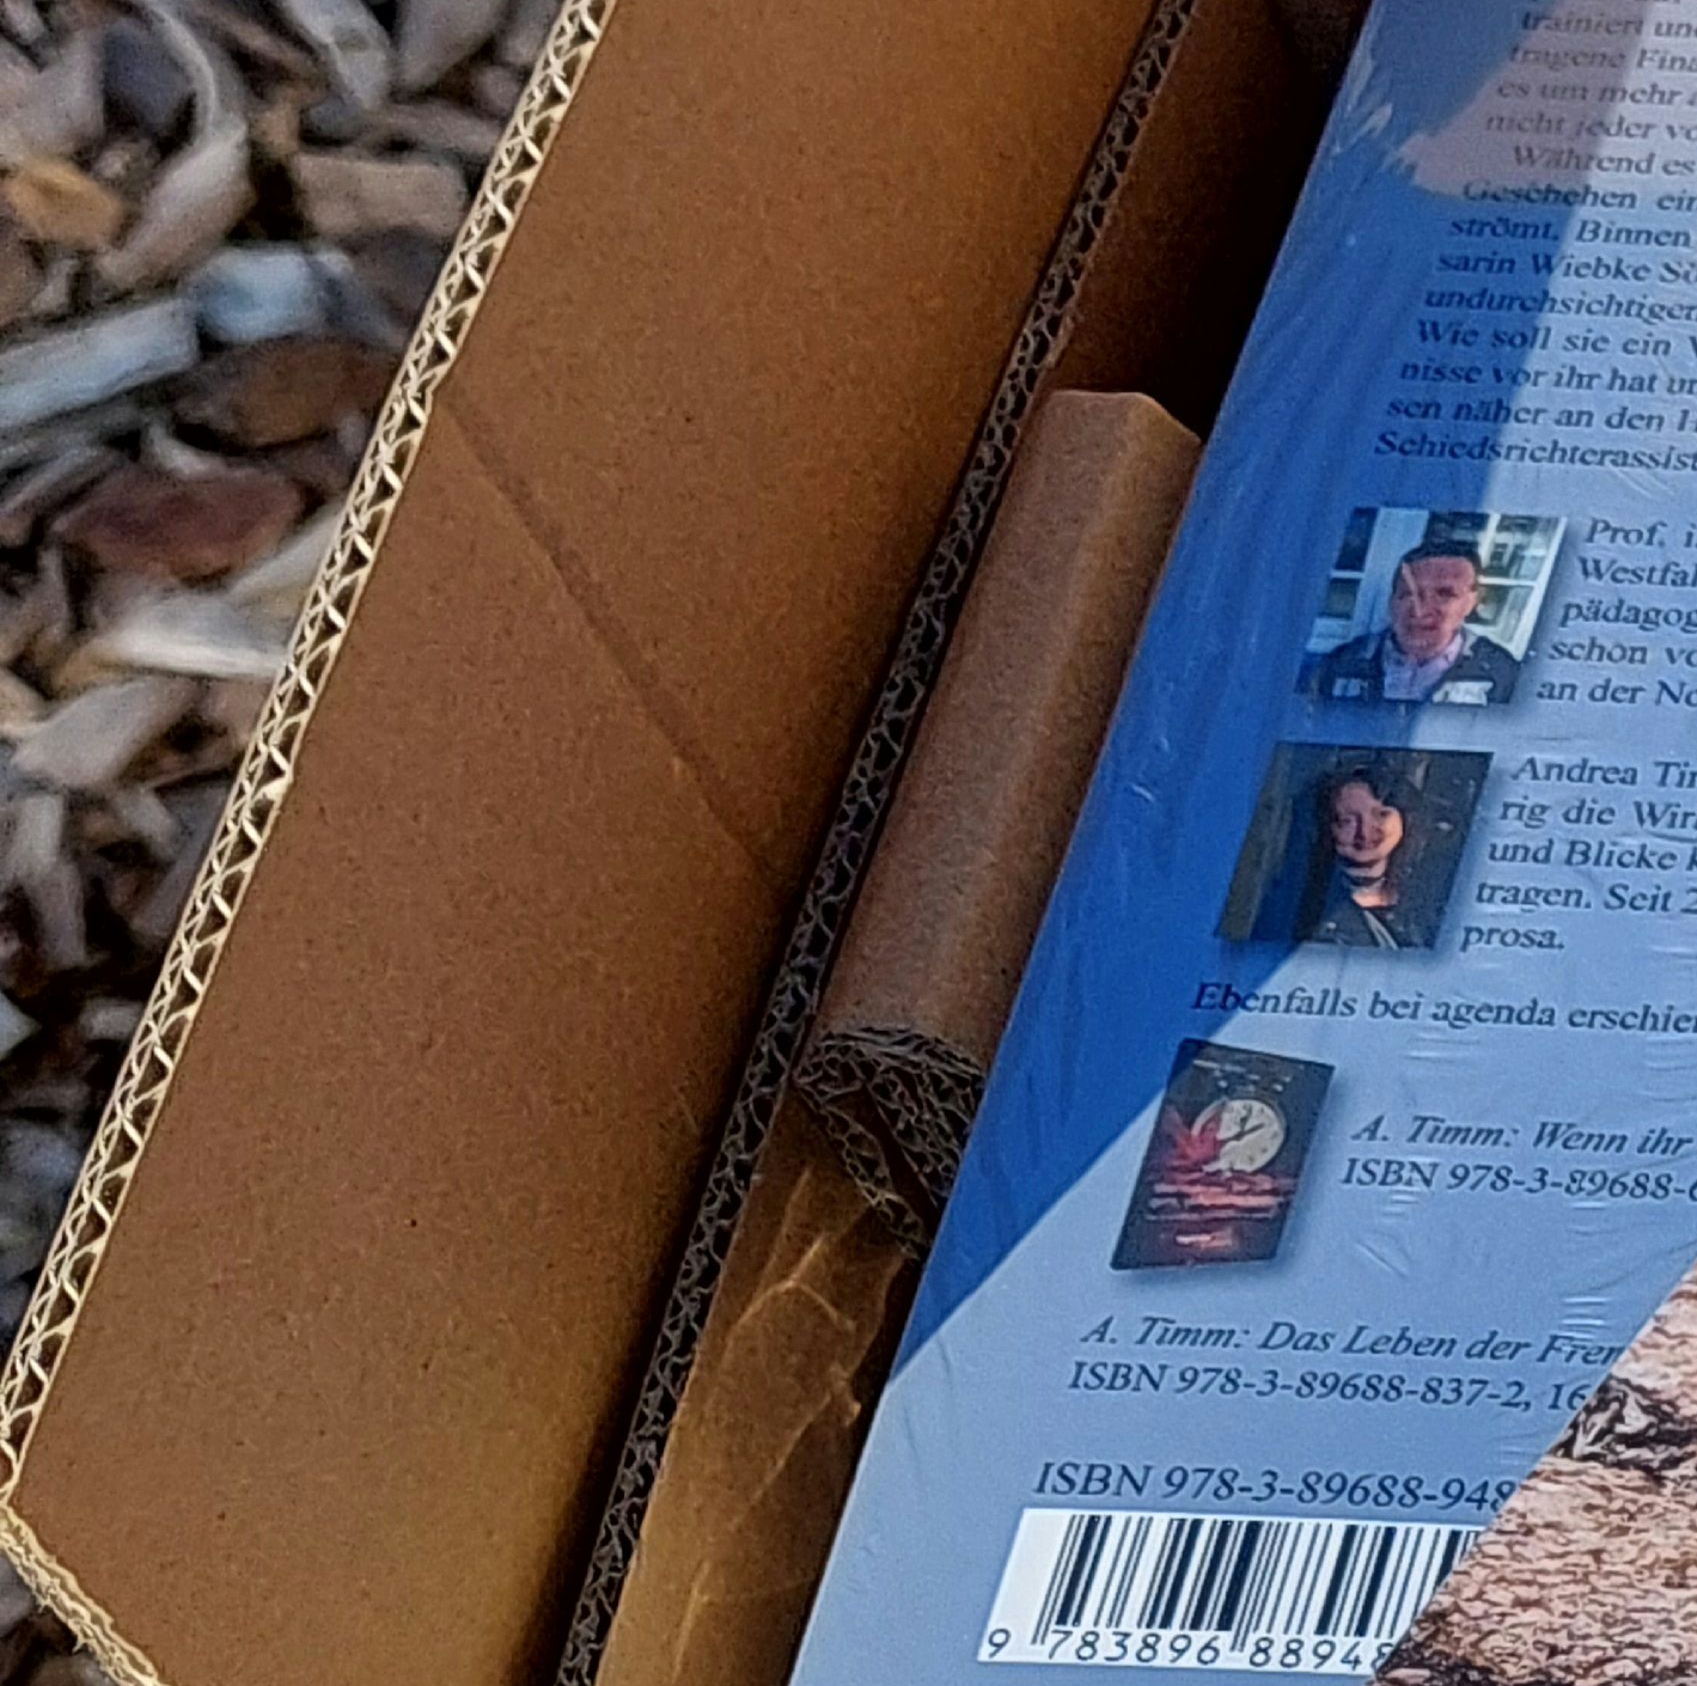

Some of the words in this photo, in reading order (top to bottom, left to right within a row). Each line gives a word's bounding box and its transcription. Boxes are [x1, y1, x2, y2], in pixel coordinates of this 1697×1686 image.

[1438, 250, 1516, 274] sarin
[1532, 253, 1651, 281] Wiebke
[1417, 319, 1479, 347] Wie
[1491, 326, 1552, 351] soll
[1562, 328, 1610, 353] sie
[1621, 331, 1671, 356] ein
[1399, 357, 1482, 384] nisse
[1492, 367, 1548, 387] vor
[1553, 364, 1599, 390] ihr
[1606, 367, 1658, 393] hat
[1386, 400, 1442, 420] sen
[1453, 399, 1548, 425] näher
[1553, 409, 1594, 428] an
[1604, 405, 1665, 432] den
[1585, 517, 1667, 548] Prof.
[1549, 635, 1648, 665] schon
[1536, 682, 1578, 702] an
[1587, 677, 1646, 704] der
[1511, 757, 1638, 786] Andrea
[1499, 794, 1552, 829] rig
[1561, 797, 1616, 825] die
[1488, 837, 1554, 865] und
[1563, 839, 1677, 870] Blicke
[1476, 882, 1591, 913] tragen.
[1603, 883, 1672, 912] Seit
[1460, 926, 1564, 952] prosa.
[1193, 982, 1357, 1017] Ebenfalls
[1367, 990, 1424, 1020] bei
[1431, 998, 1555, 1030] agenda
[1351, 1114, 1389, 1142] A.
[1406, 1114, 1519, 1147] Timm:
[1532, 1121, 1628, 1153] Wenn
[1636, 1126, 1693, 1155] ihr
[1342, 1157, 1439, 1188] ISBN
[1079, 1315, 1117, 1344] A.
[1135, 1315, 1250, 1348] Timm:
[1257, 1321, 1336, 1352] Das
[1341, 1325, 1457, 1358] Leben
[1464, 1330, 1532, 1360] der
[1068, 1361, 1168, 1392] ISBN
[1035, 1461, 1152, 1496] ISBN
[988, 1627, 1011, 1657] 9
[1048, 1628, 1220, 1664] 783896
